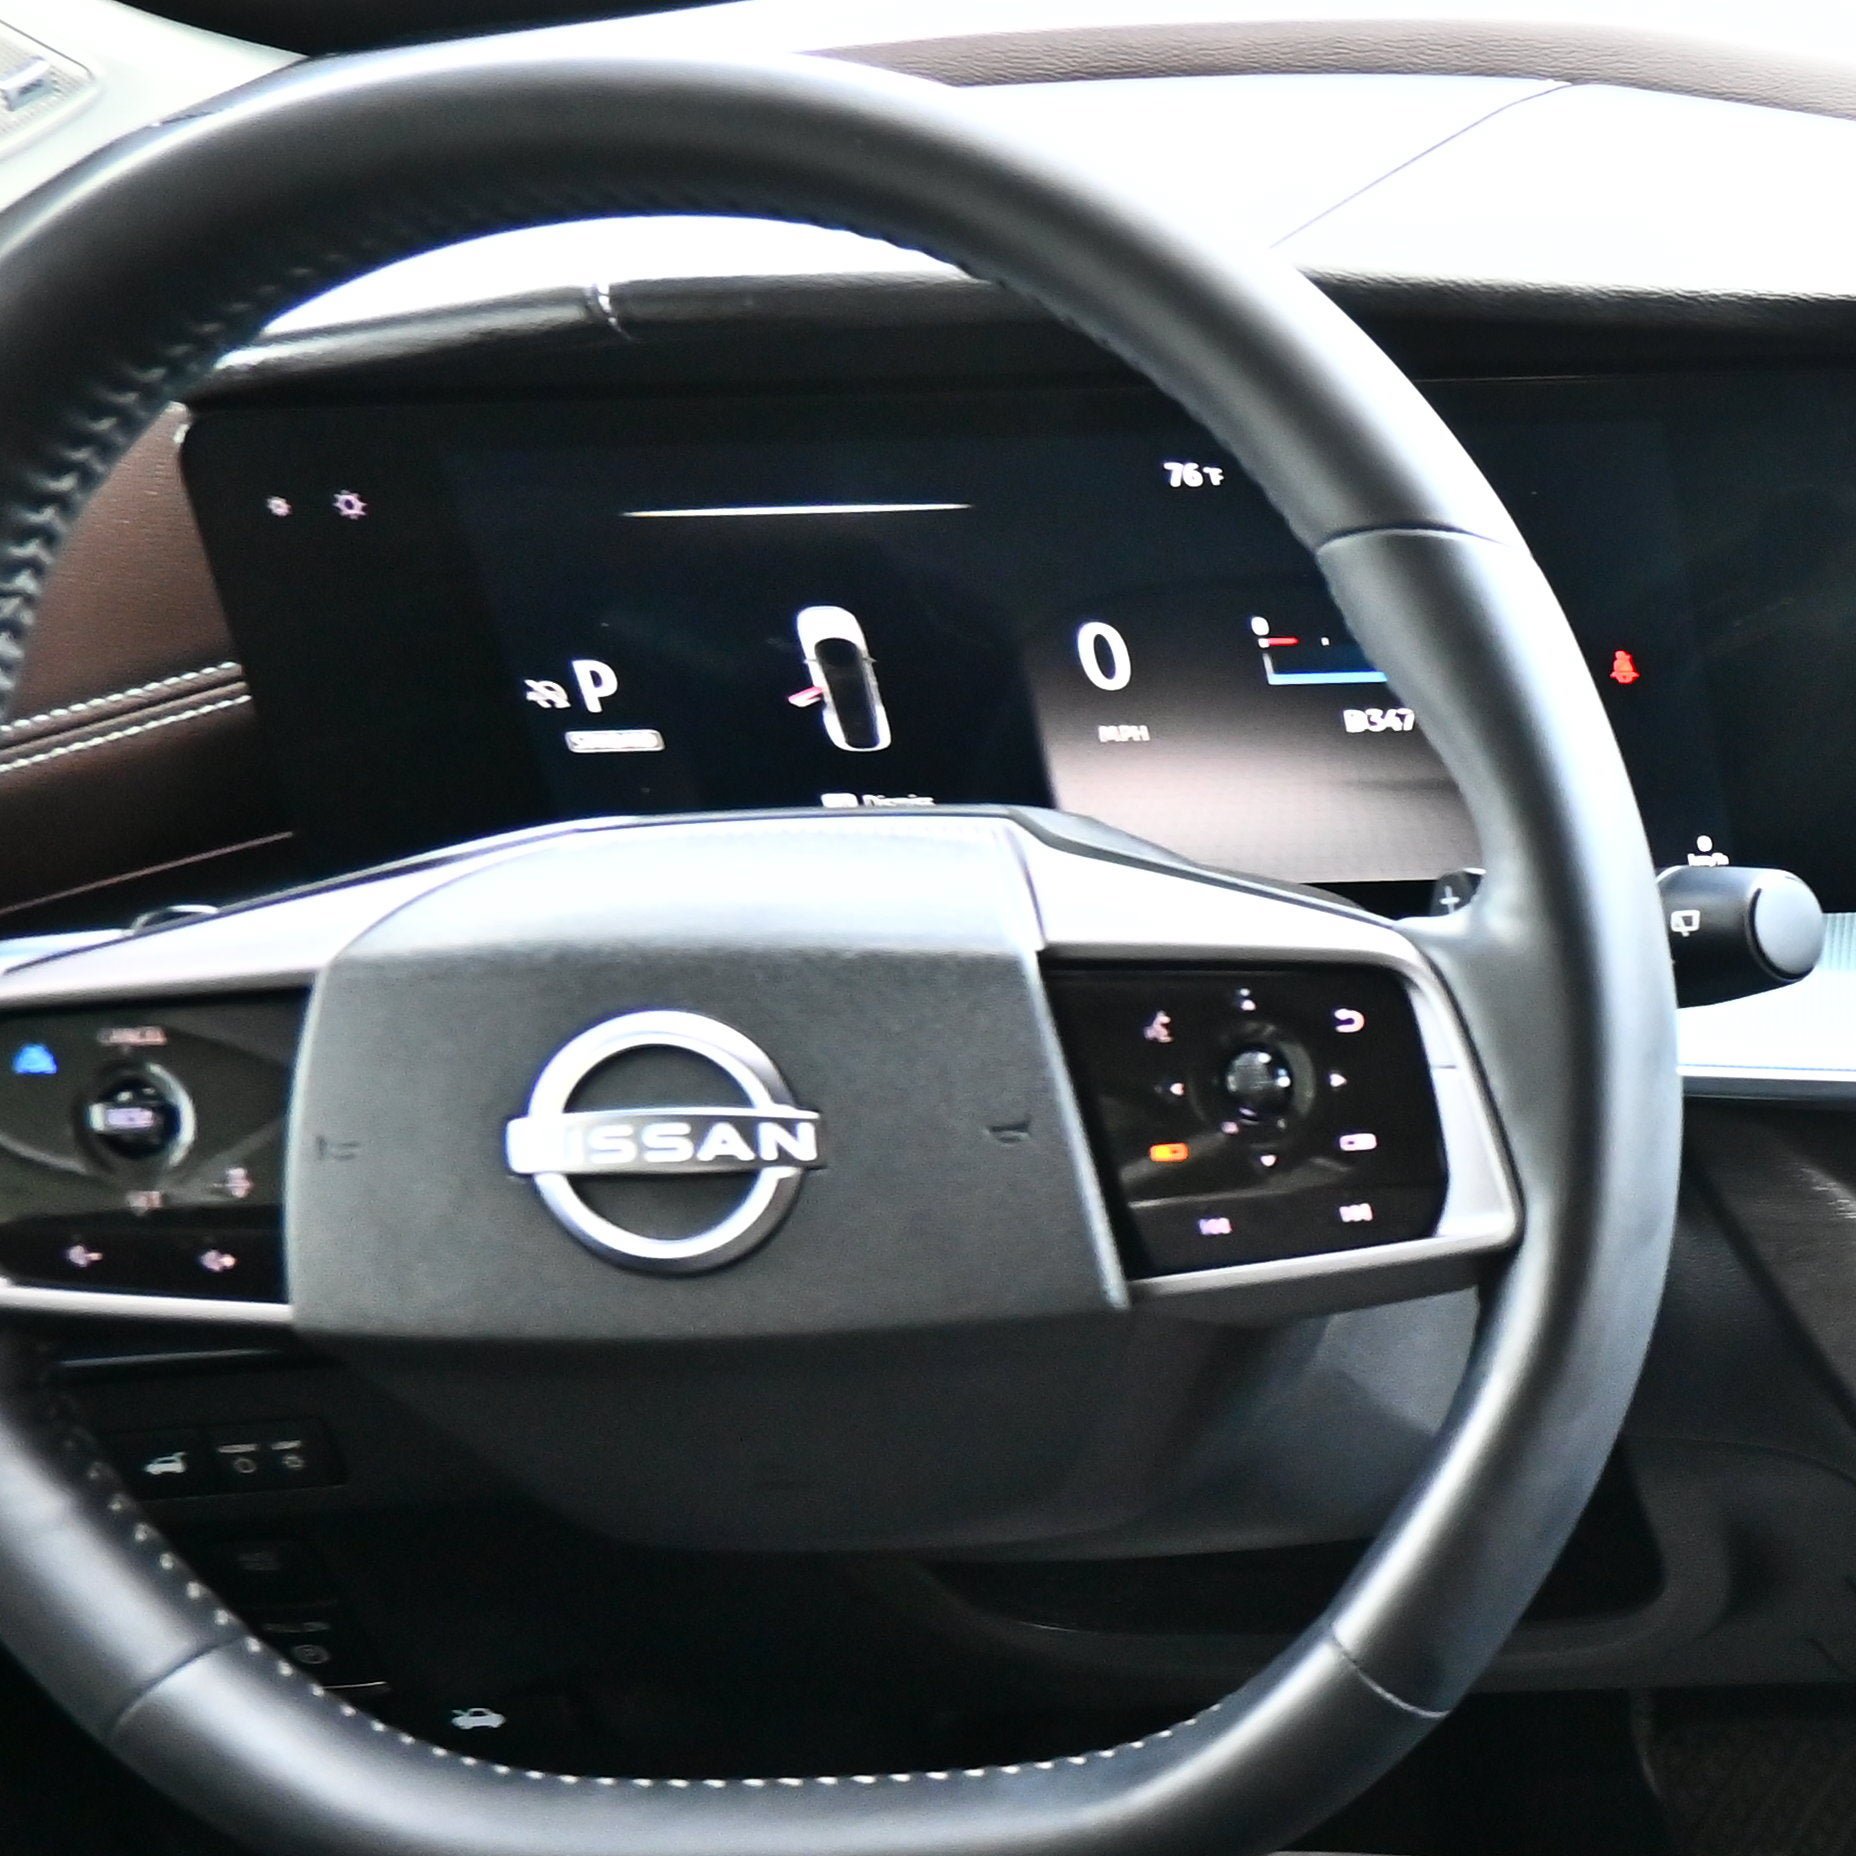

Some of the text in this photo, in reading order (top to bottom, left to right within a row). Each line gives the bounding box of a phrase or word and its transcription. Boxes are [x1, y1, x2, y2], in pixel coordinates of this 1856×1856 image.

[1078, 622, 1131, 691] 0
[572, 659, 618, 713] P
[516, 1122, 817, 1164] ISSAN
